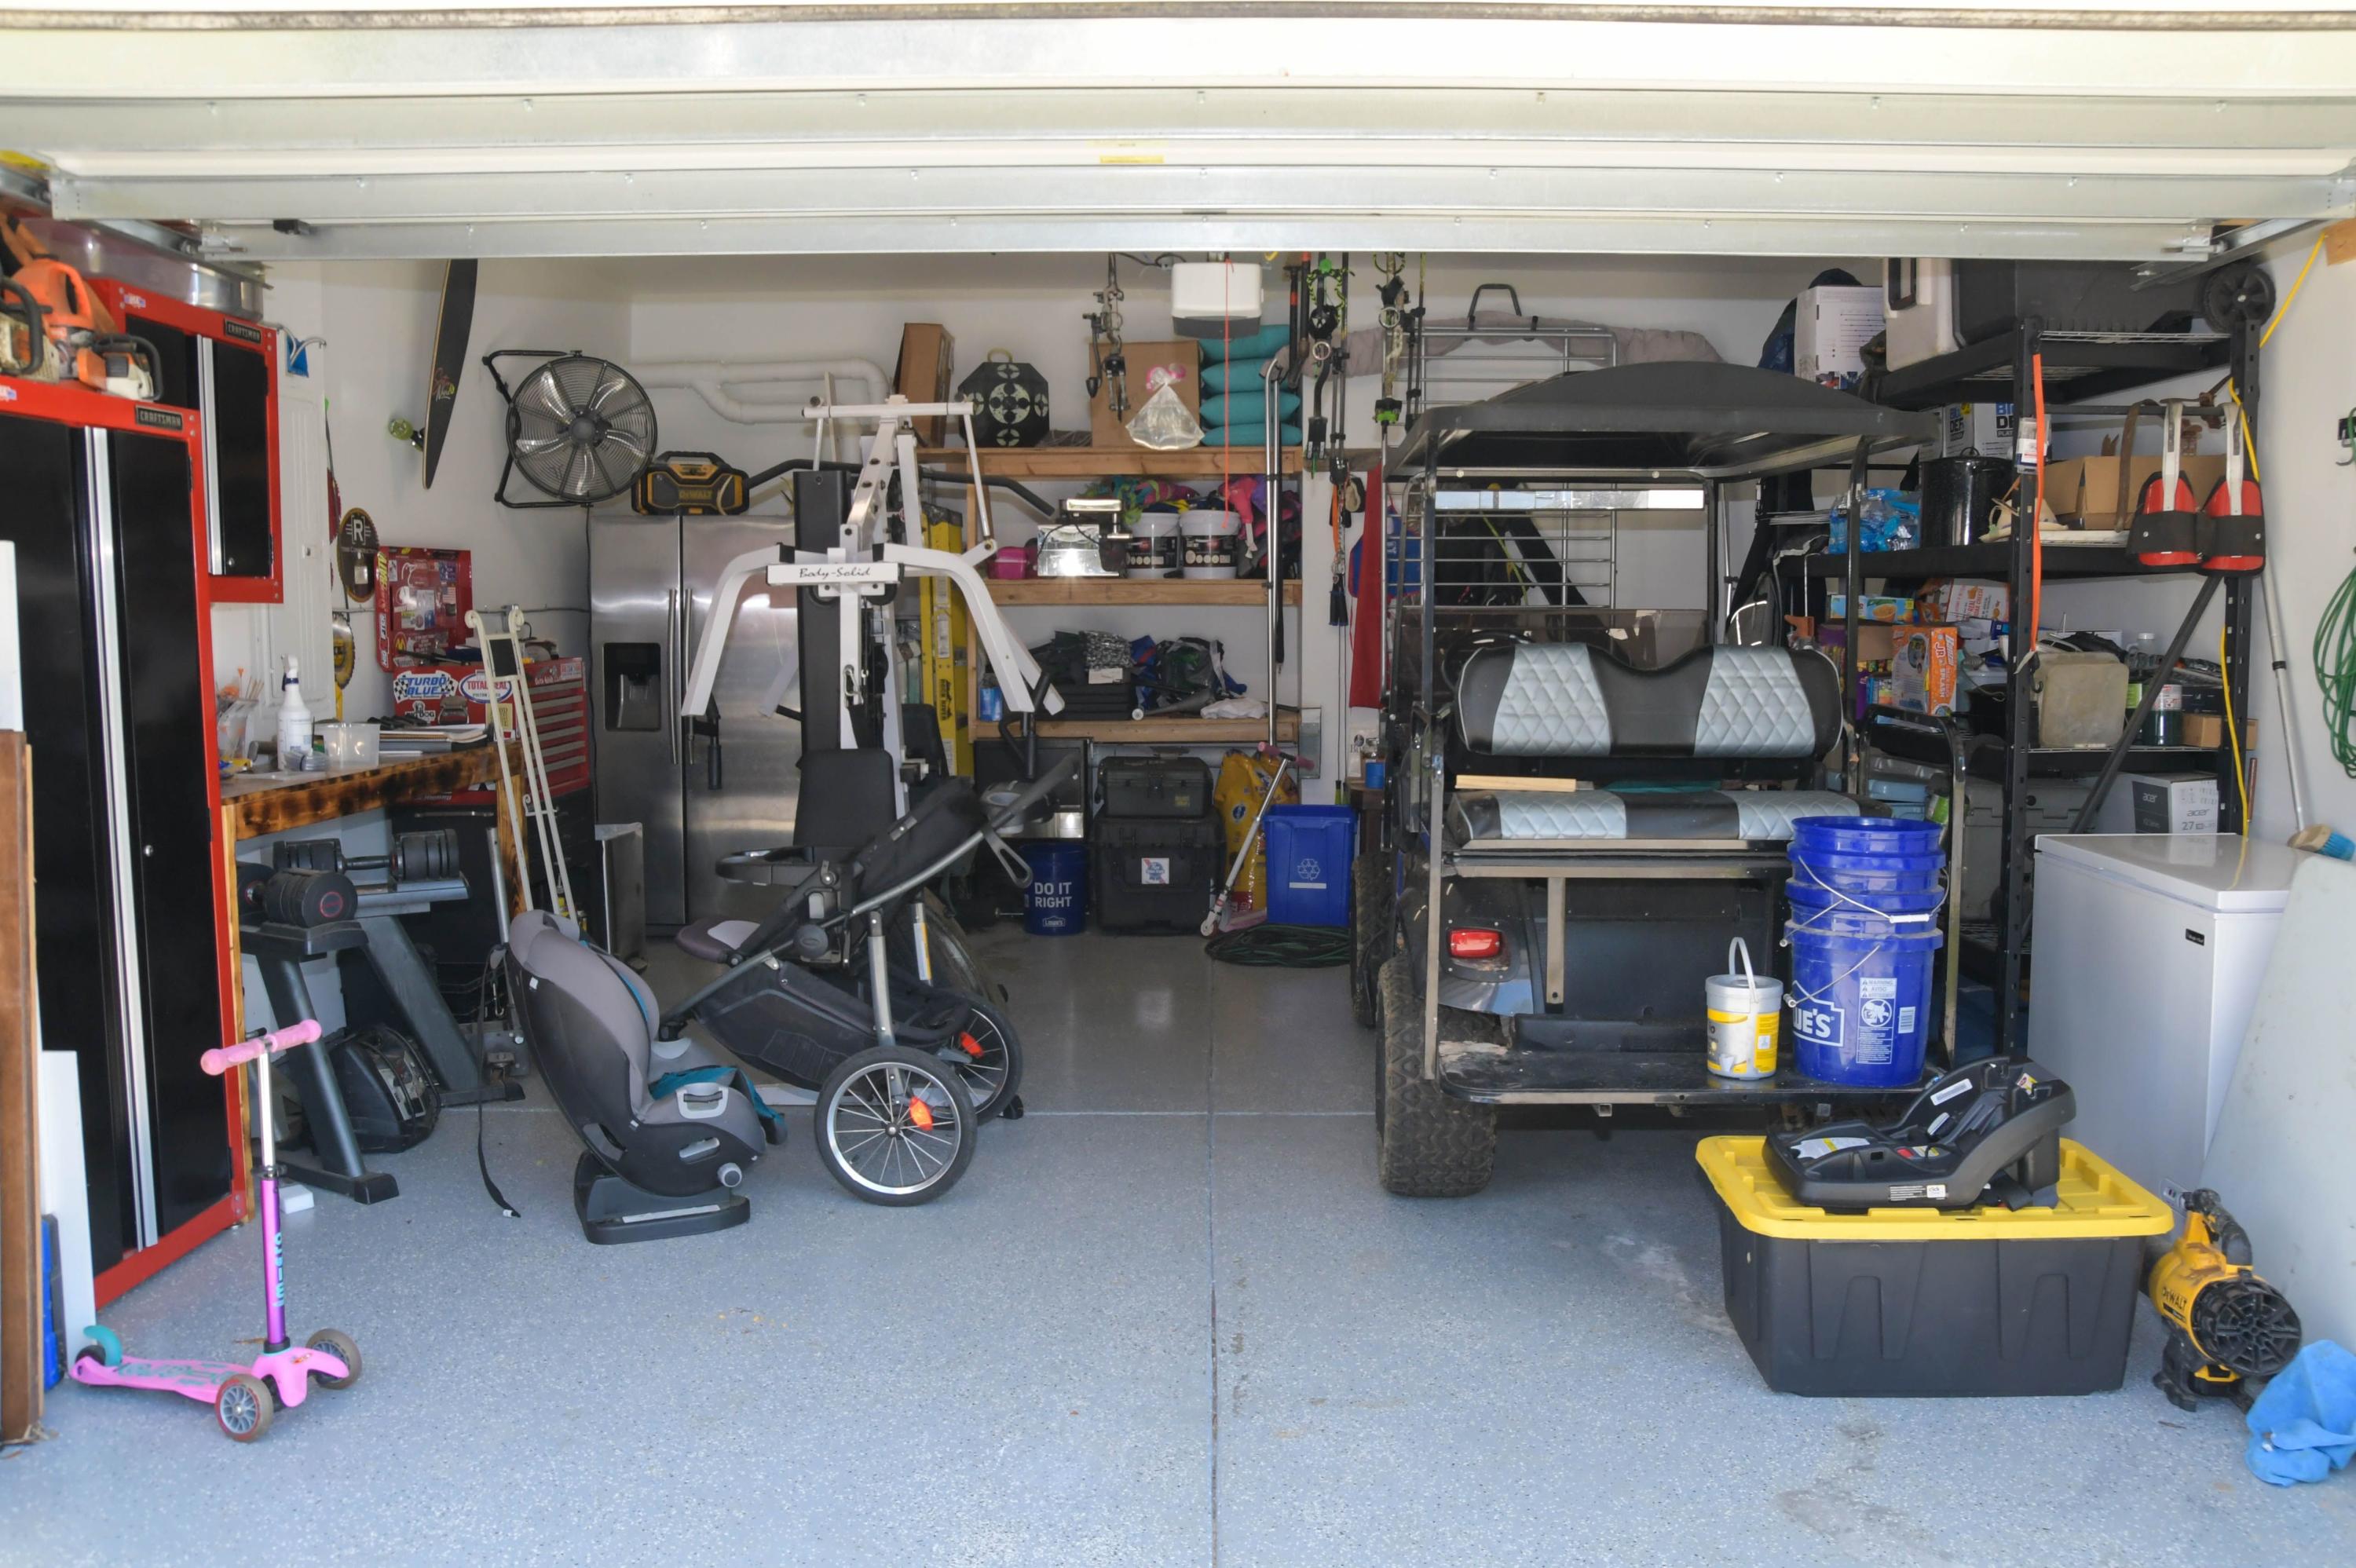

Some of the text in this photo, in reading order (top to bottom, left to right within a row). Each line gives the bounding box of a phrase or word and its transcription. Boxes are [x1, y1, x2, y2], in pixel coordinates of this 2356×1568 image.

[228, 323, 260, 342] CRAFTSMAN
[140, 409, 181, 429] CRAFTSMAN
[353, 519, 364, 542] R
[799, 567, 871, 579] Body-Solid
[408, 677, 447, 686] TURBO
[493, 680, 507, 690] EAL
[407, 686, 440, 696] BLUE
[2142, 792, 2157, 803] acer
[2186, 808, 2211, 817] acer
[1034, 882, 1072, 895] DO IT
[1035, 896, 1072, 908] RIGHT
